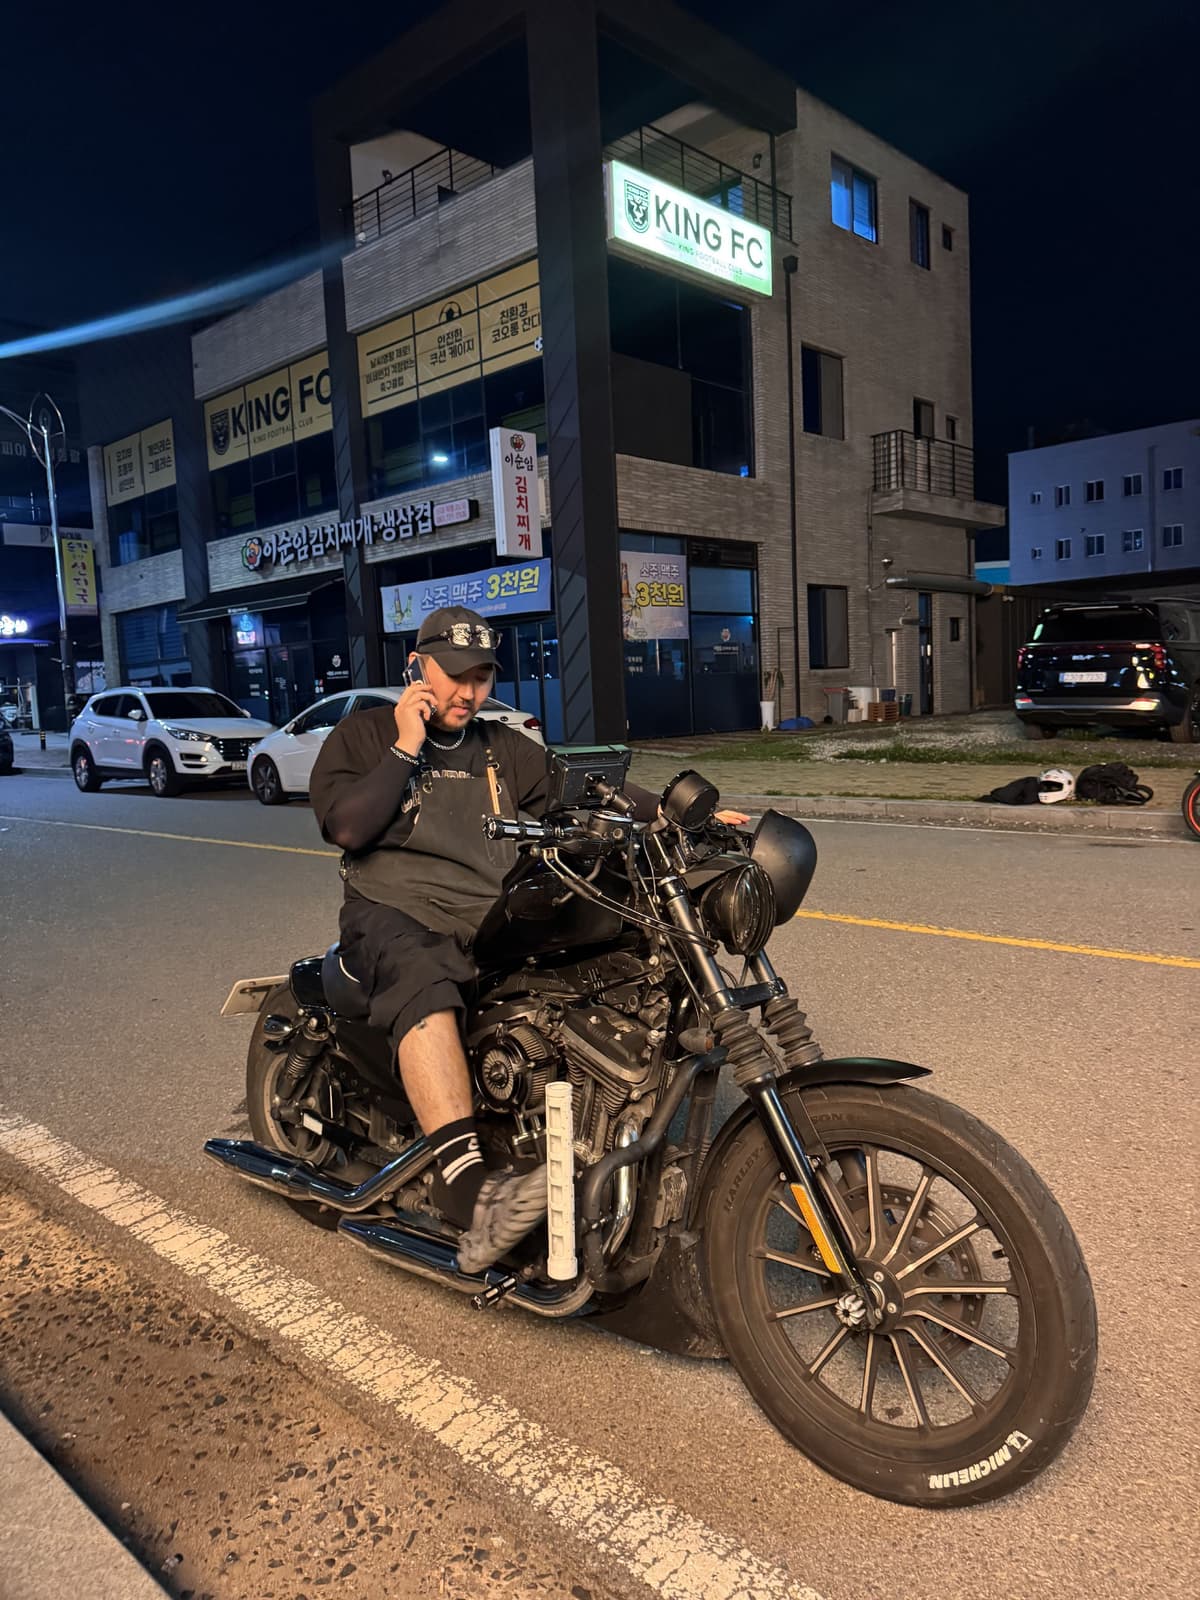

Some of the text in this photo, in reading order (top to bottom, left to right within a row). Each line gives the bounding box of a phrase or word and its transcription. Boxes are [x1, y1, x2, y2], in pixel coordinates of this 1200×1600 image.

[655, 194, 763, 269] KING FC
[500, 301, 528, 325] 친환경
[522, 312, 541, 332] 잔디
[430, 338, 475, 366] 쿠션 케이지
[437, 328, 463, 349] 안전한
[231, 367, 333, 439] KING FC
[505, 453, 534, 472] 이순임
[515, 476, 531, 551] 김치찌개
[486, 566, 540, 600] 3천원
[635, 581, 685, 608] 3천원
[928, 1444, 1012, 1489] MICHELIN
